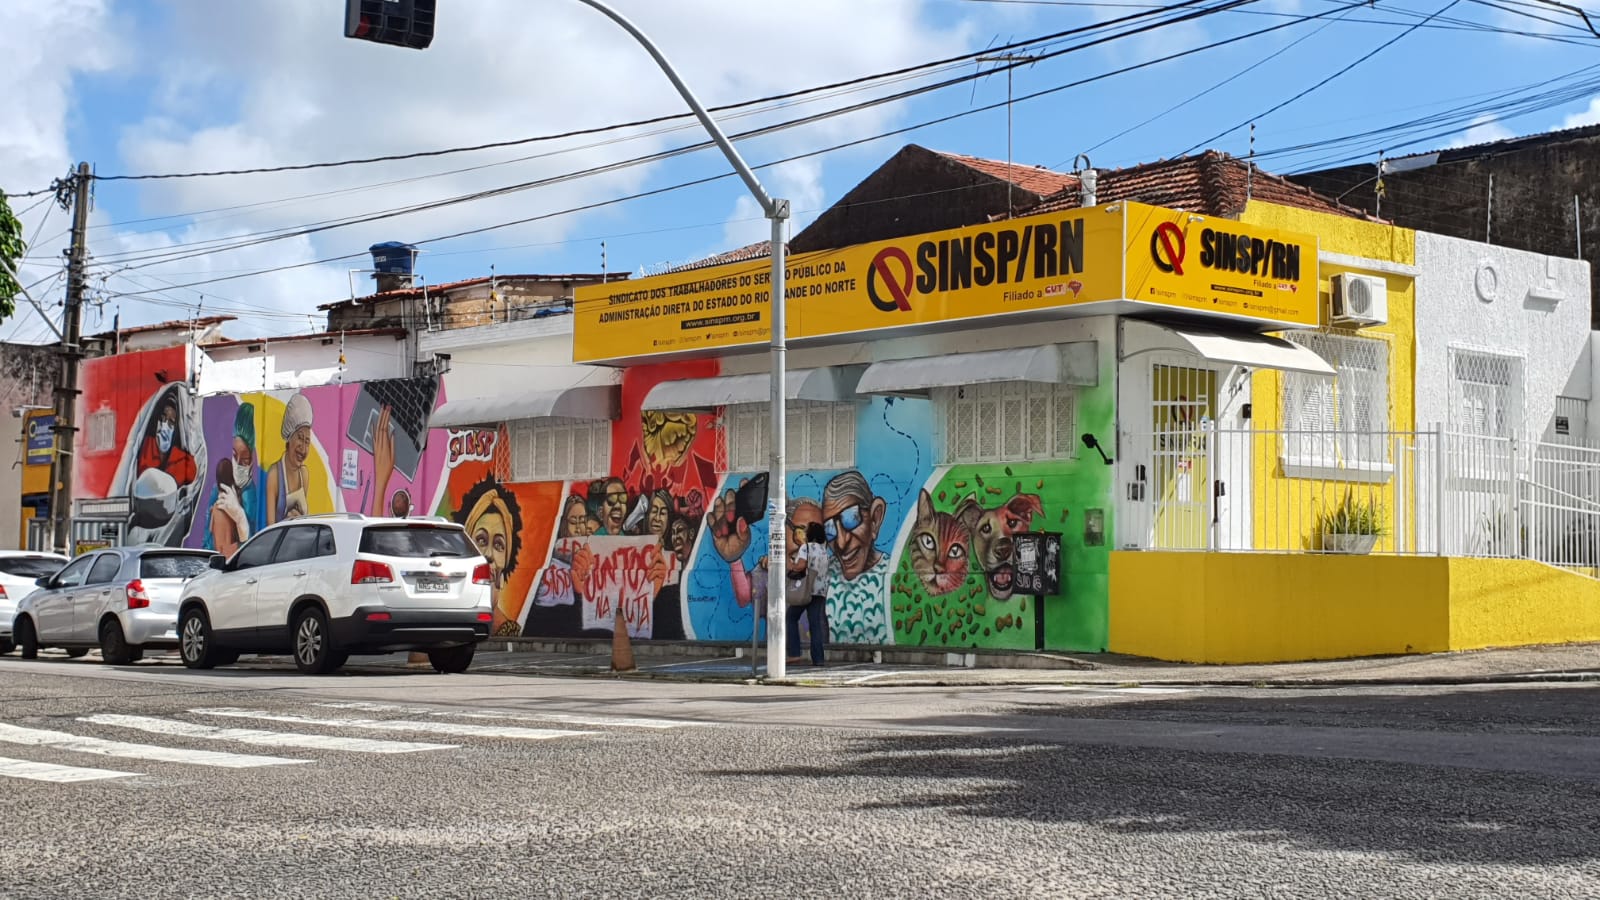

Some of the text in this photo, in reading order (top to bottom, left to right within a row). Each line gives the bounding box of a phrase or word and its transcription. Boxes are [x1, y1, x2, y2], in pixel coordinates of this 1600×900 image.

[916, 218, 1084, 295] SINSP/RN
[1200, 228, 1300, 282] SINSP/RN
[599, 304, 660, 323] ADMINISTRAÇÃO
[663, 302, 690, 316] DIRETA
[693, 300, 703, 311] DO
[706, 295, 737, 310] ESTADO
[740, 294, 752, 305] DO
[755, 291, 769, 303] RIO
[810, 284, 822, 296] DO
[825, 279, 856, 294] NORTE
[608, 261, 846, 305] SINDICATO DOS TRABALHADORES DO SERO PÚBLICO DA
[1003, 284, 1063, 302] Filiado a CUT
[1253, 279, 1272, 289] Filiado
[449, 430, 495, 462] SINSP
[595, 595, 612, 619] NA
